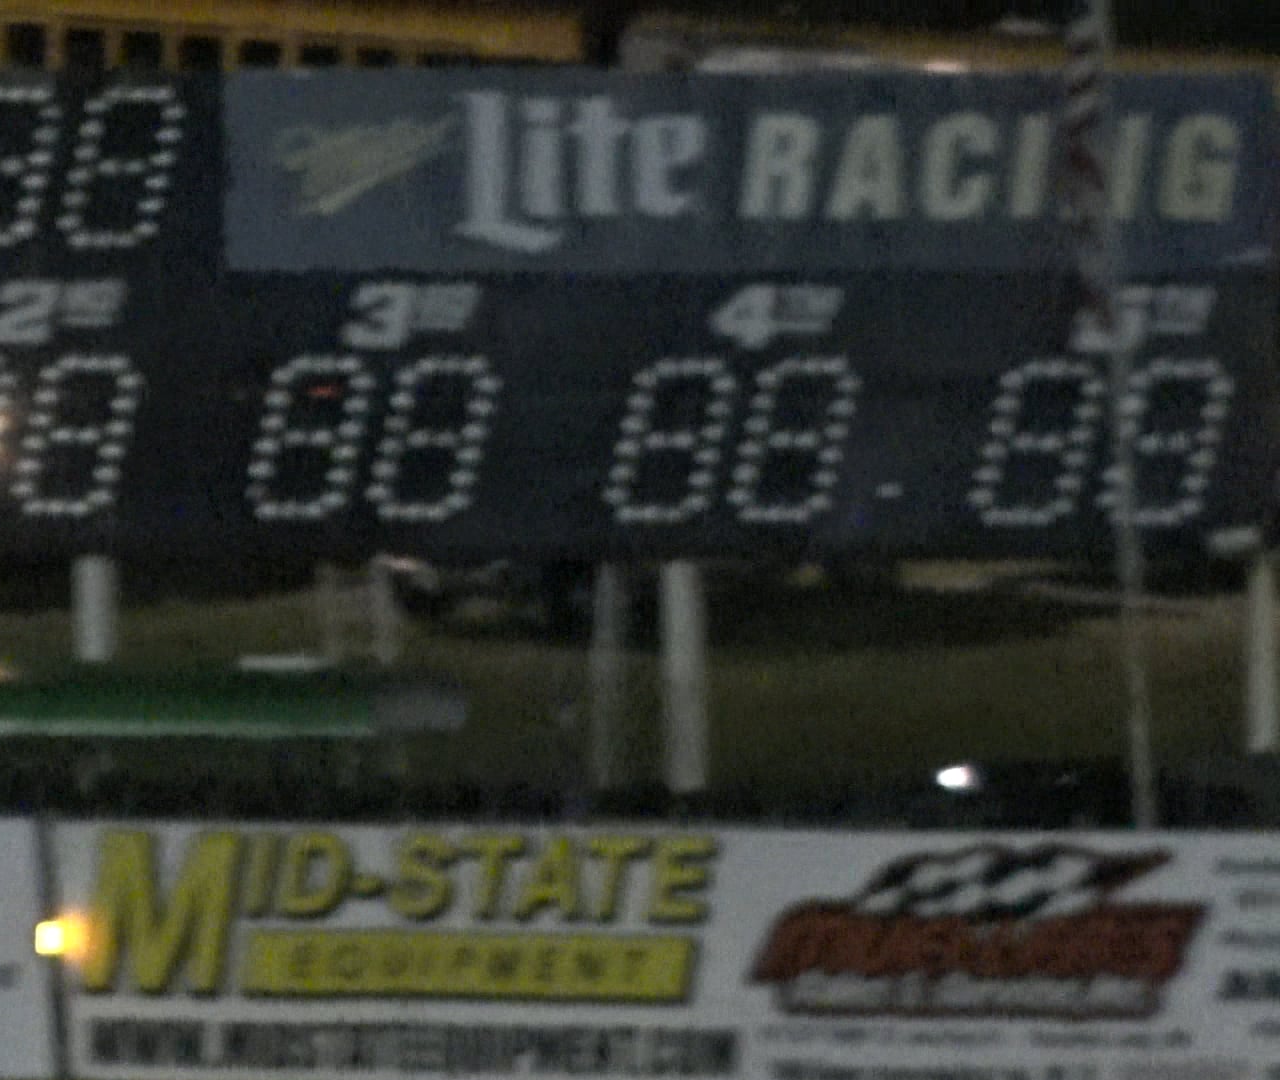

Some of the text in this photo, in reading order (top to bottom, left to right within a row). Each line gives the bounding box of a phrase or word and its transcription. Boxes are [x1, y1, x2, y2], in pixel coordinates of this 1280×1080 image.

[453, 90, 708, 252] Lite
[80, 828, 718, 998] MID-STATE
[286, 936, 654, 980] EQUIPMENT
